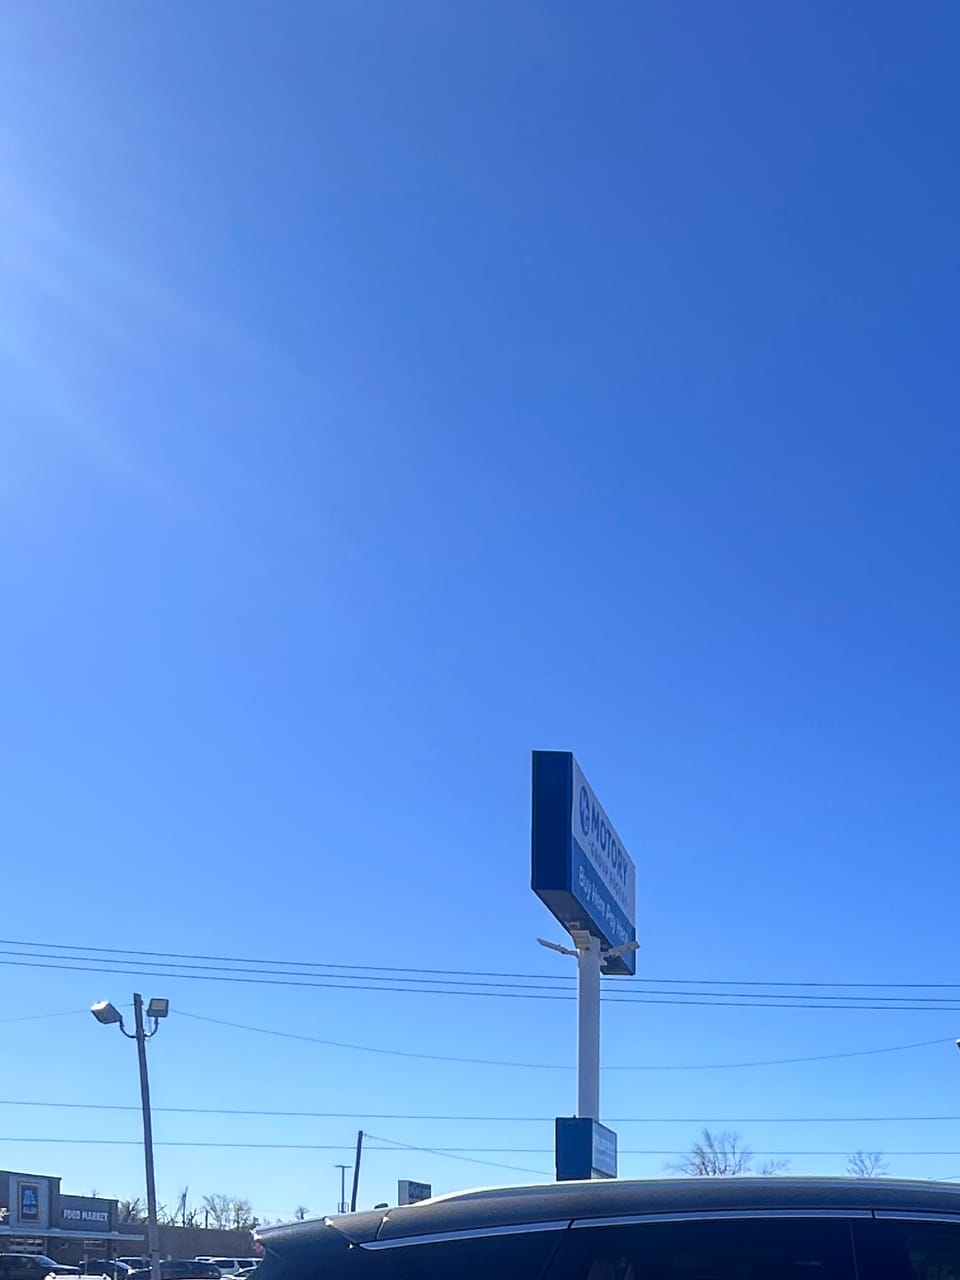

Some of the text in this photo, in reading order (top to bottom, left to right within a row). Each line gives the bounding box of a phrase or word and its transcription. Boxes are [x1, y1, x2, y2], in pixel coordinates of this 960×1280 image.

[592, 803, 627, 886] MOTORY
[63, 1209, 108, 1222] FOOD MARKET
